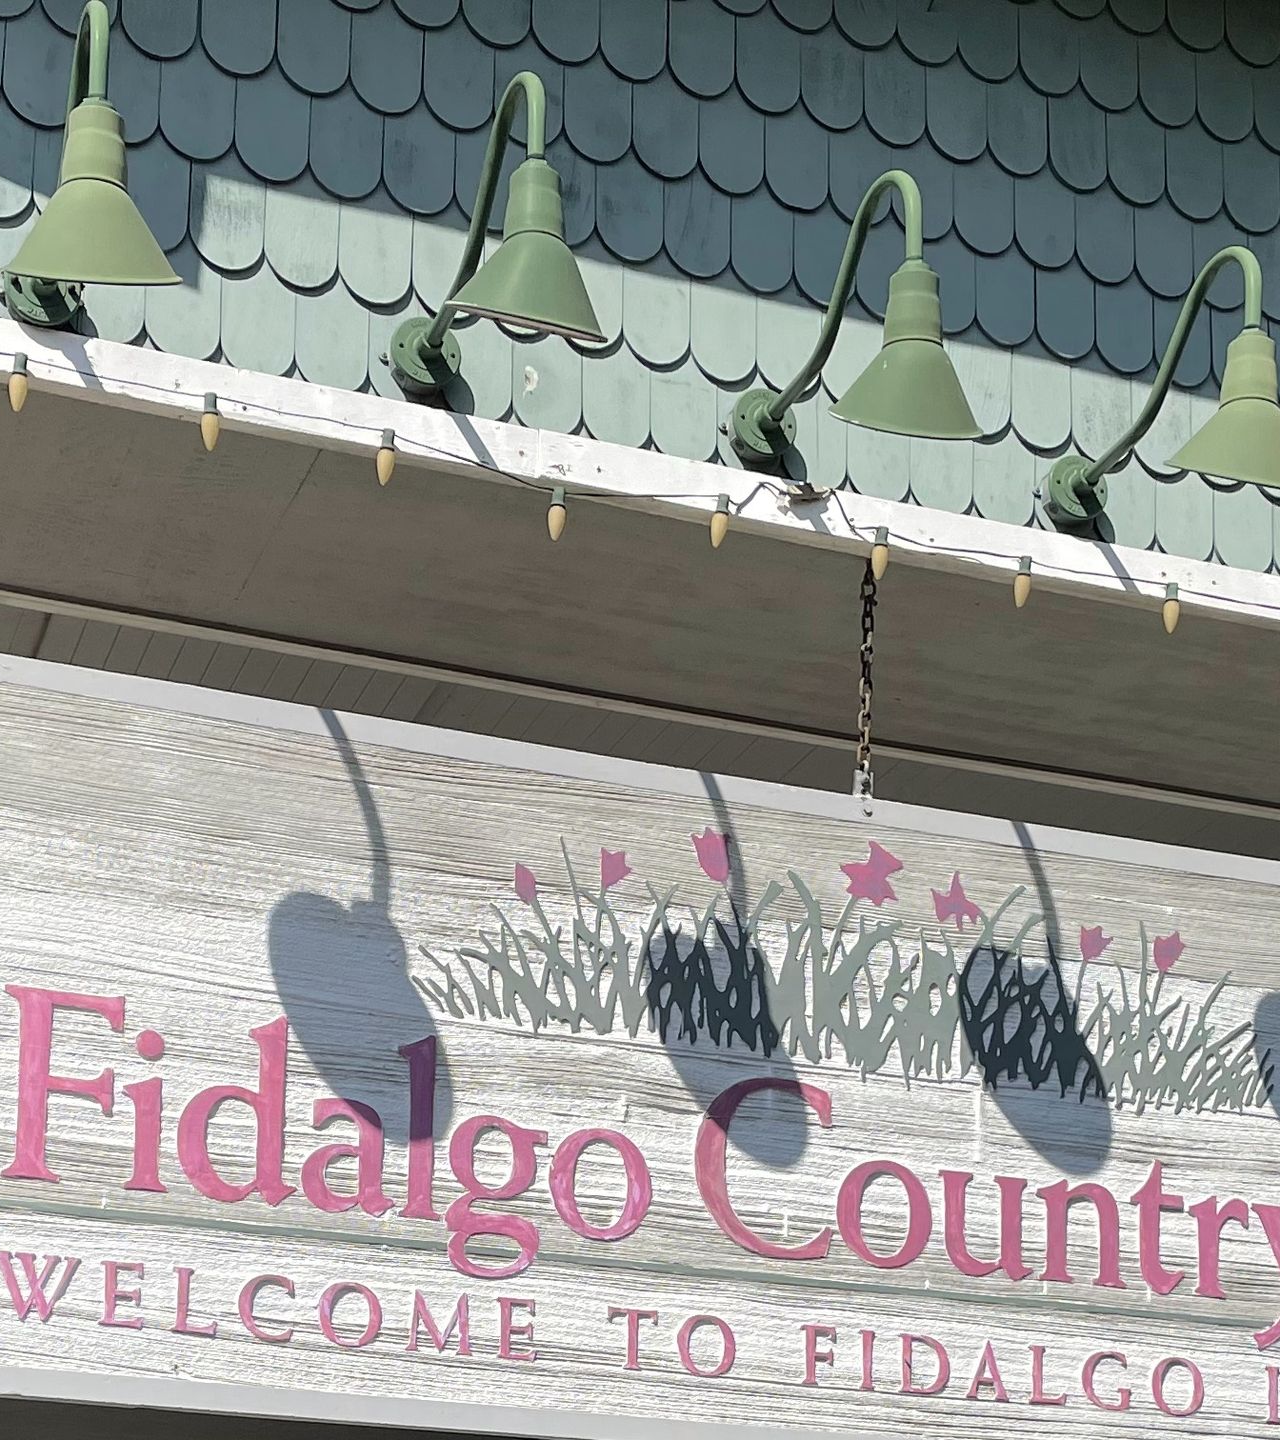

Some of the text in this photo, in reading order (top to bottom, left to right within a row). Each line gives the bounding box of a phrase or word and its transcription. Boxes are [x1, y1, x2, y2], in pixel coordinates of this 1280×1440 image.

[1, 984, 653, 1279] Fidalgo
[607, 1306, 737, 1377] TO
[802, 1323, 1205, 1417] FIDALGO
